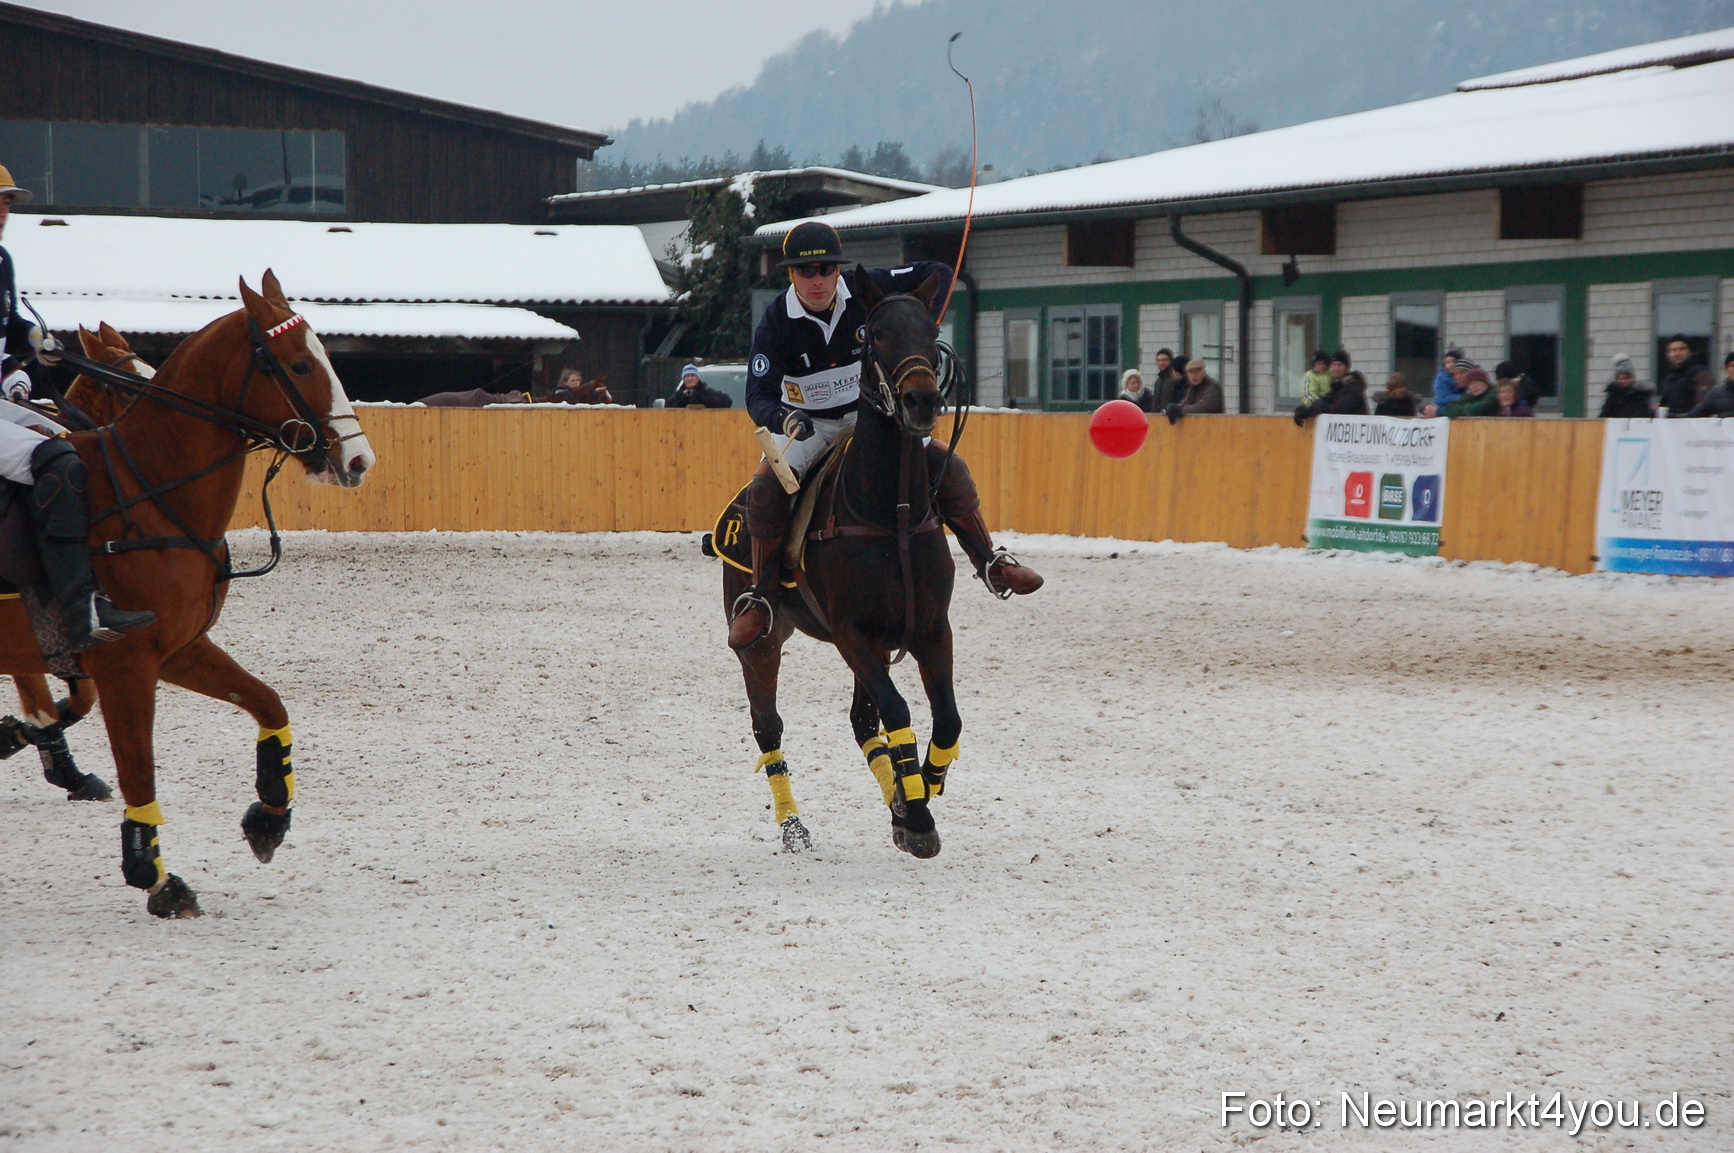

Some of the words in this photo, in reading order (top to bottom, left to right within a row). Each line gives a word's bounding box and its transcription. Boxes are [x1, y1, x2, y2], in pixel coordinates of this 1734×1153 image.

[800, 352, 811, 368] 1
[1384, 490, 1403, 503] BASE
[1622, 490, 1663, 511] MEYER
[723, 519, 741, 547] R
[1409, 531, 1421, 544] 922
[1431, 532, 1440, 546] 72
